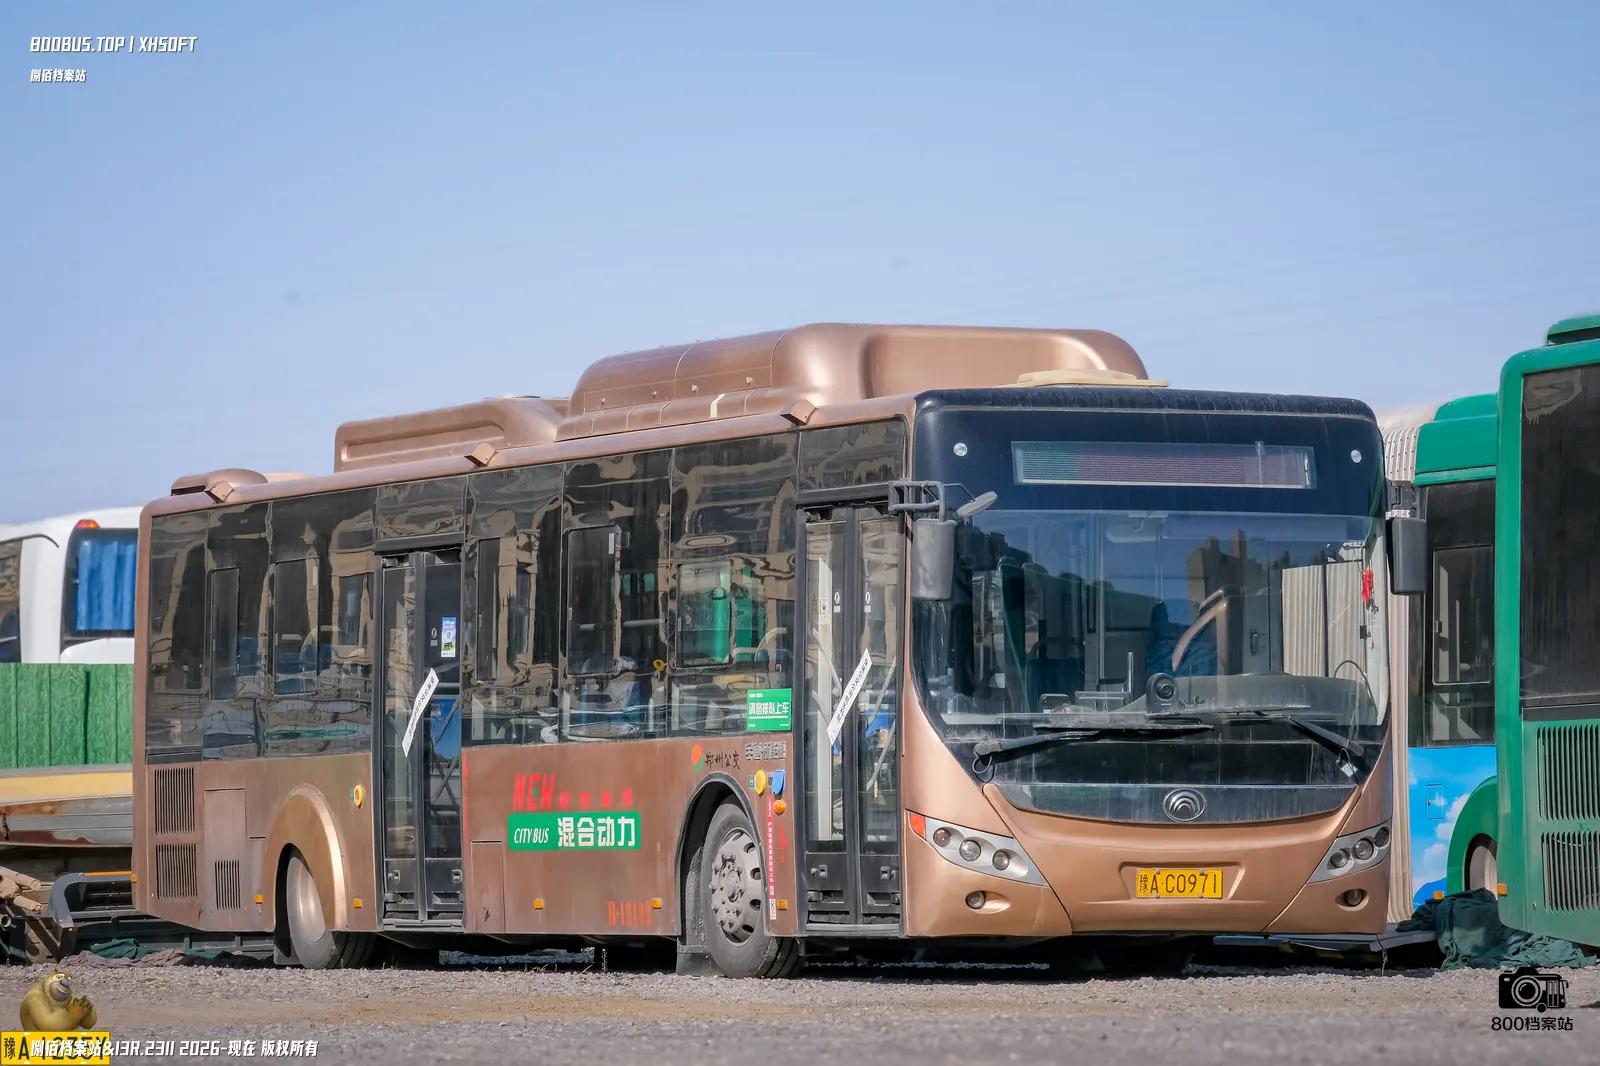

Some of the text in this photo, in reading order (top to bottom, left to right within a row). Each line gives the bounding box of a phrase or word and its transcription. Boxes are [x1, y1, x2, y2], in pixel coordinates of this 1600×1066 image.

[512, 773, 556, 810] NEW
[513, 828, 549, 844] CITY BUS
[557, 816, 635, 847] 混合动力
